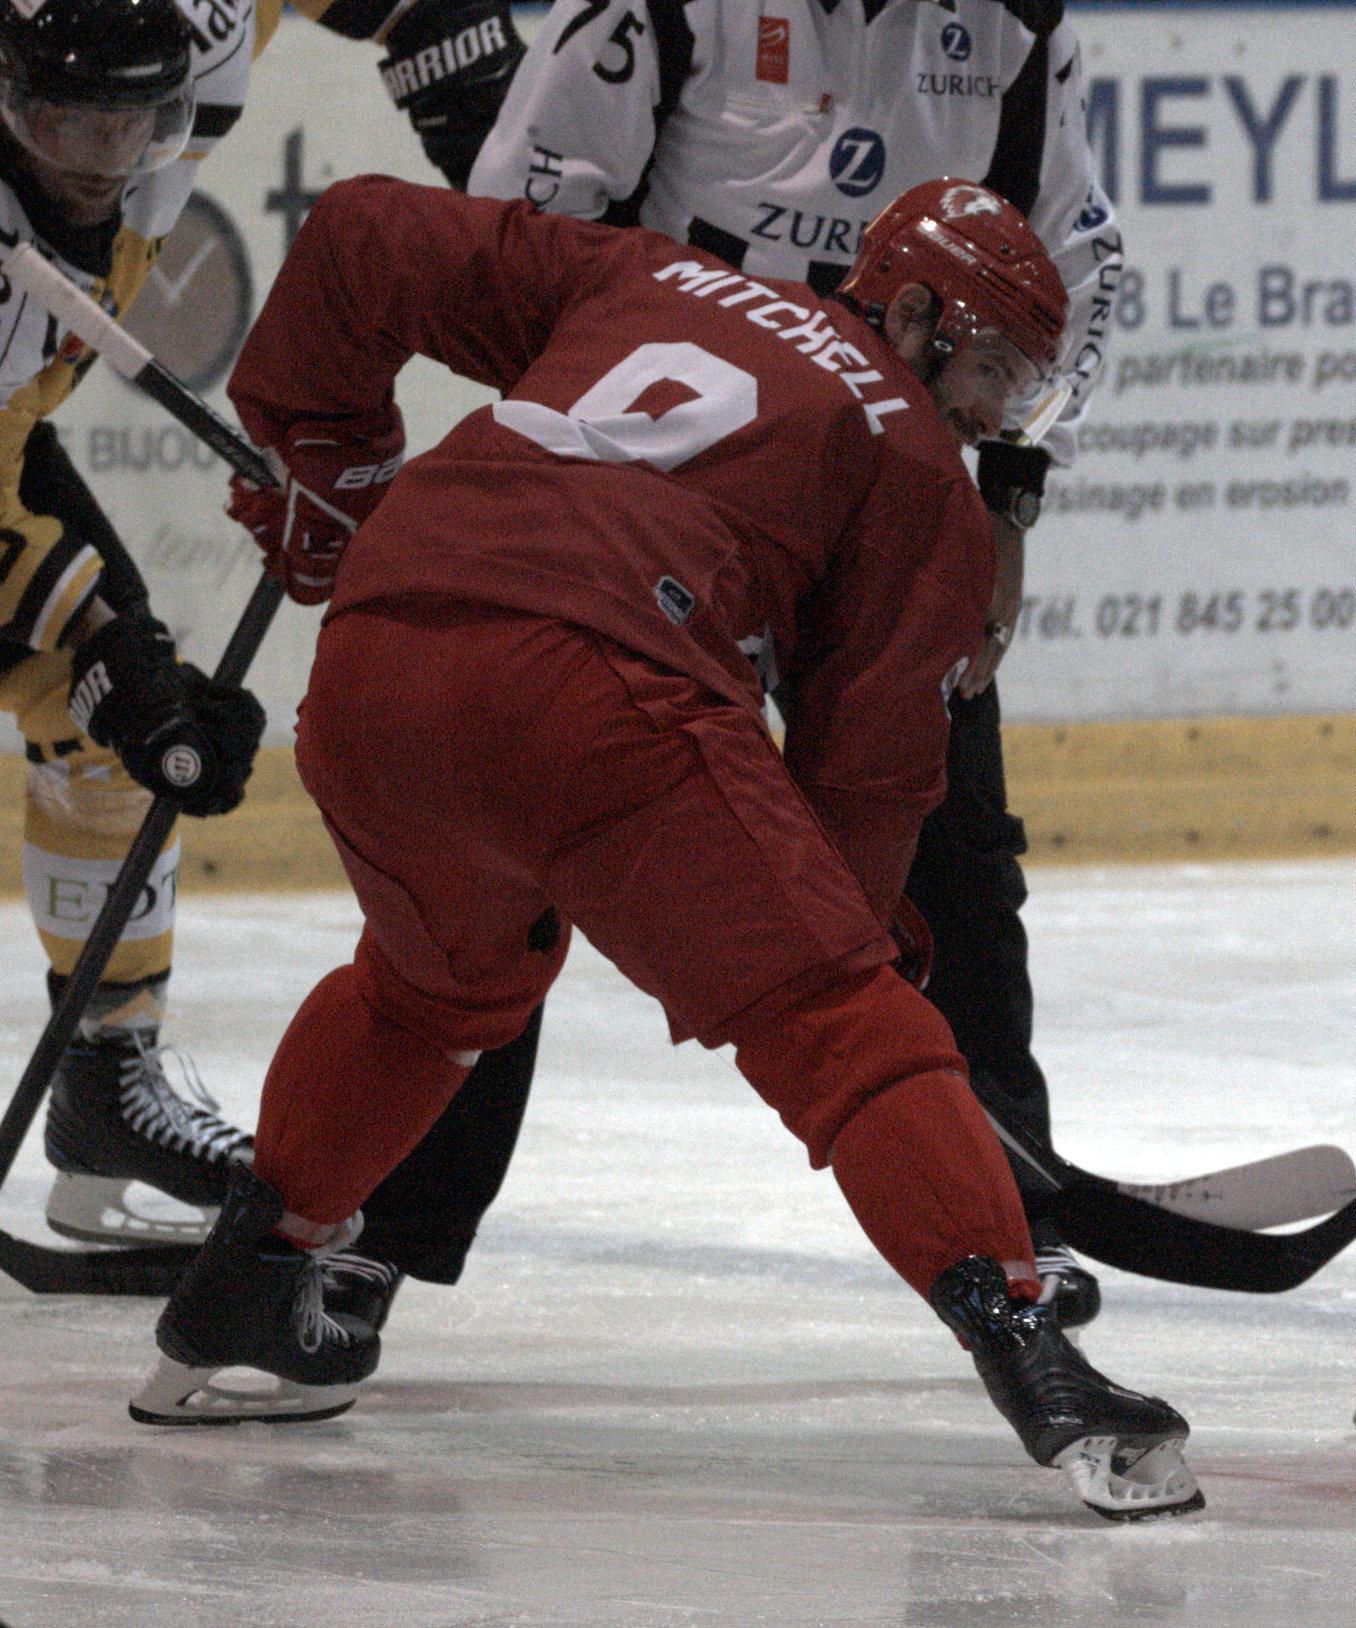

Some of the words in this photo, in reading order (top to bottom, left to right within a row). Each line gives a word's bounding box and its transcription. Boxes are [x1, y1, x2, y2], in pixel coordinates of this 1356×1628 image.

[1169, 267, 1235, 329] Le
[652, 259, 912, 436] MITCHELL
[1116, 346, 1304, 395] partenaire
[88, 429, 217, 477] BIJOU
[1077, 416, 1216, 461] coupage
[1227, 418, 1281, 449] sur
[1174, 480, 1214, 511] en
[1096, 592, 1163, 640] 021
[1176, 589, 1244, 635] 845
[1256, 588, 1299, 634] 25
